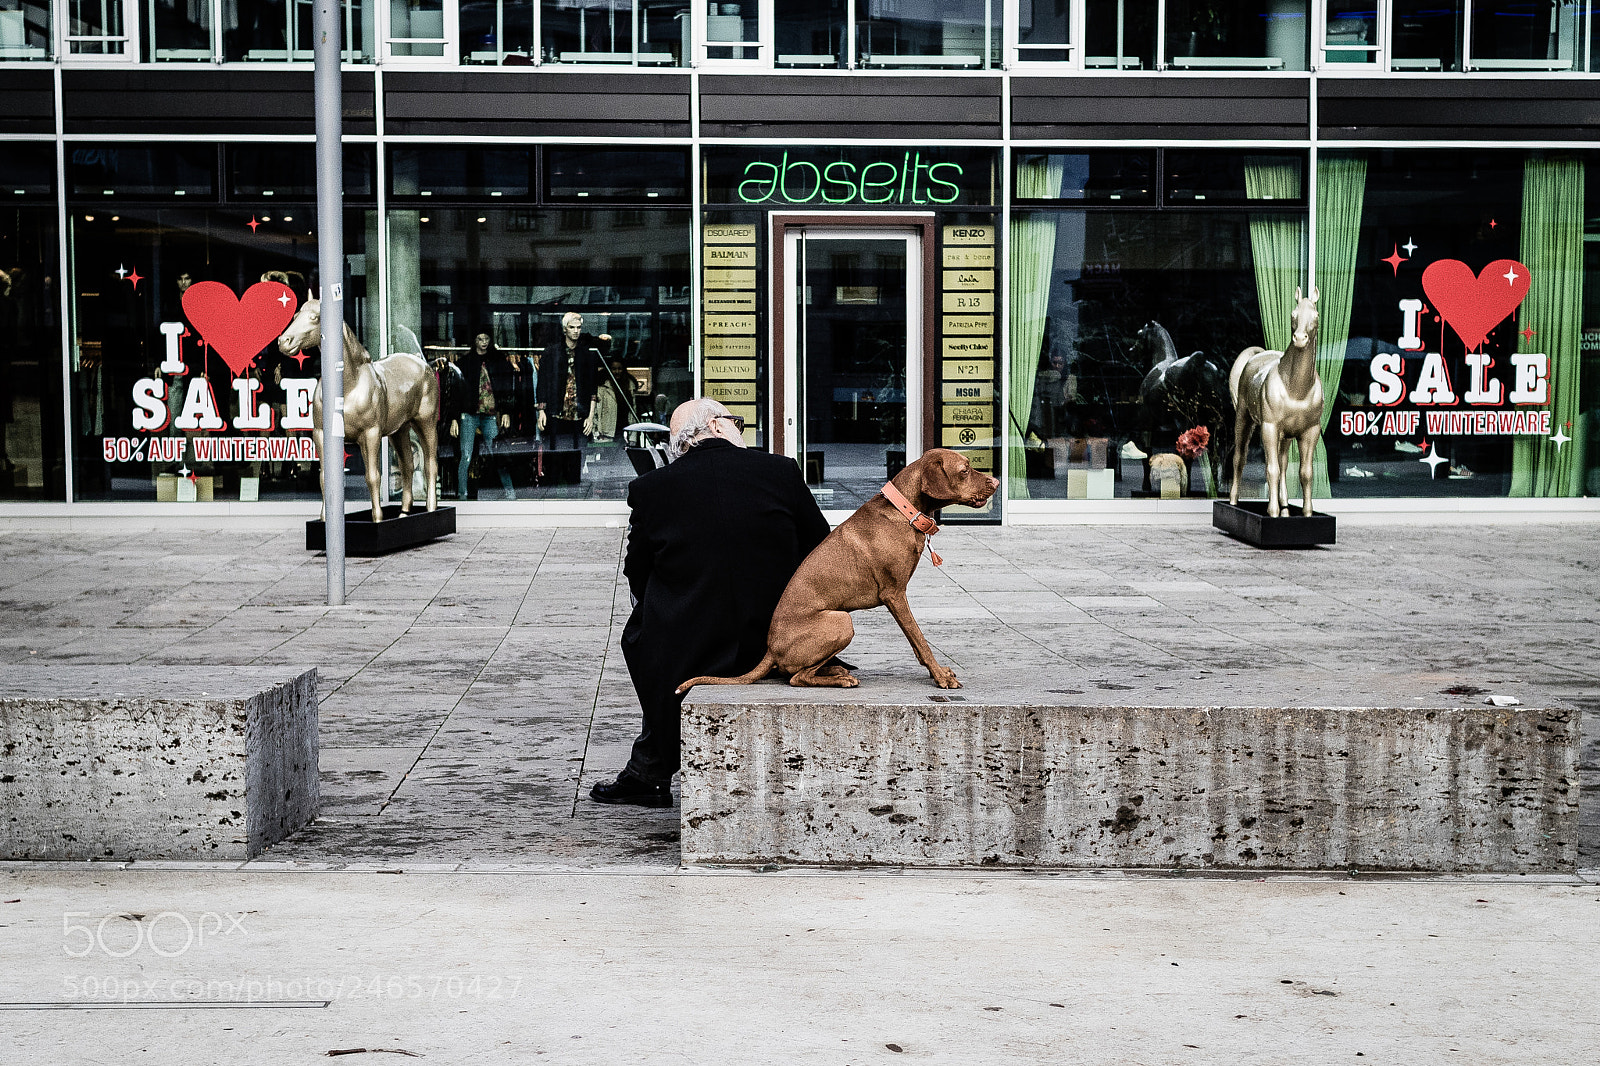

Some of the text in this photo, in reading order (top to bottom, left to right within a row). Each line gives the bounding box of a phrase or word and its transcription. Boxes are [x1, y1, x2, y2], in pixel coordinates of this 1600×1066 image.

[952, 229, 985, 238] KENZO
[711, 251, 748, 259] BALMAIN
[957, 298, 980, 307] R 13
[1398, 298, 1429, 352] I
[160, 321, 190, 376] I
[1369, 353, 1551, 406] SALE
[712, 388, 749, 396] PLEIN SUD
[955, 387, 981, 397] MSGM
[132, 377, 318, 432] SALE
[1426, 410, 1551, 435] WINTERWARE
